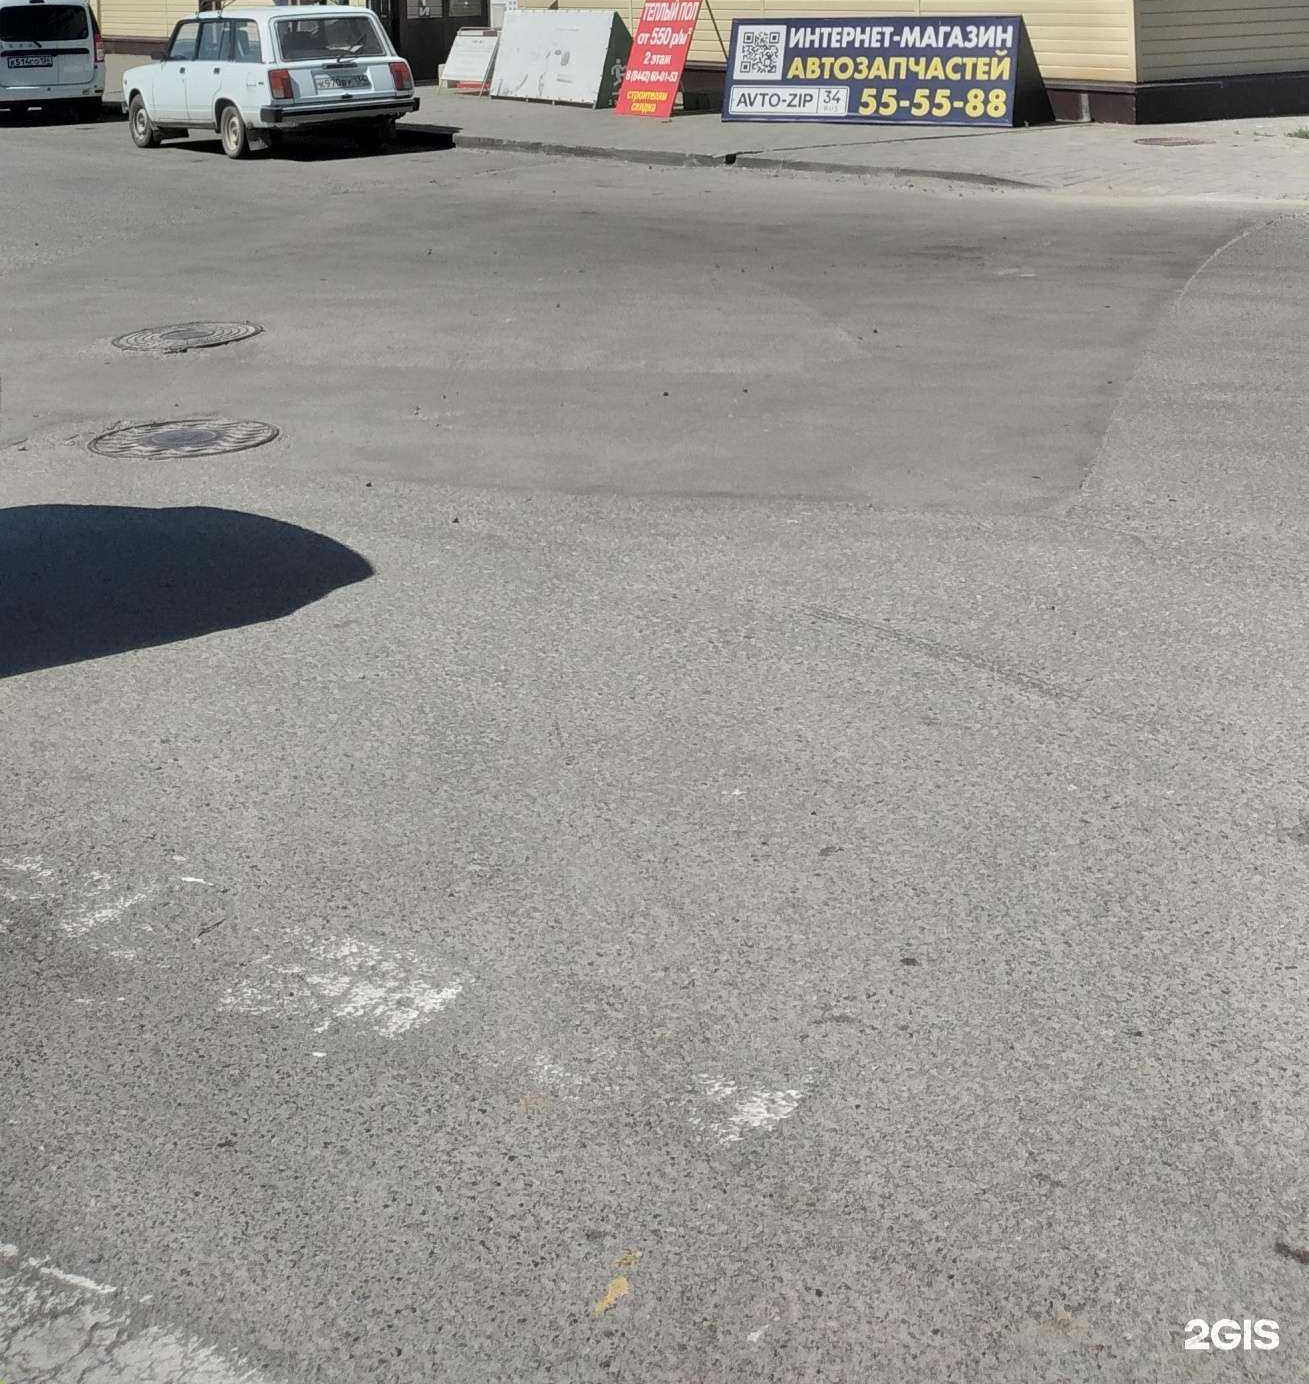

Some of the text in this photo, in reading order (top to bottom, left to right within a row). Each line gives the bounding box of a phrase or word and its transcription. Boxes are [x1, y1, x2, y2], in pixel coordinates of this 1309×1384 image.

[677, 1, 700, 20] ПОЛ
[637, 33, 648, 44] от
[650, 27, 672, 45] 550
[788, 26, 1013, 49] ИНТЕРНЕТ-МАГАЗИН
[643, 51, 651, 65] 2
[786, 50, 1011, 80] АВТОЗАПЧАСТЕЙ
[736, 88, 1008, 117] AVTO-ZIP 34 55-55-88
